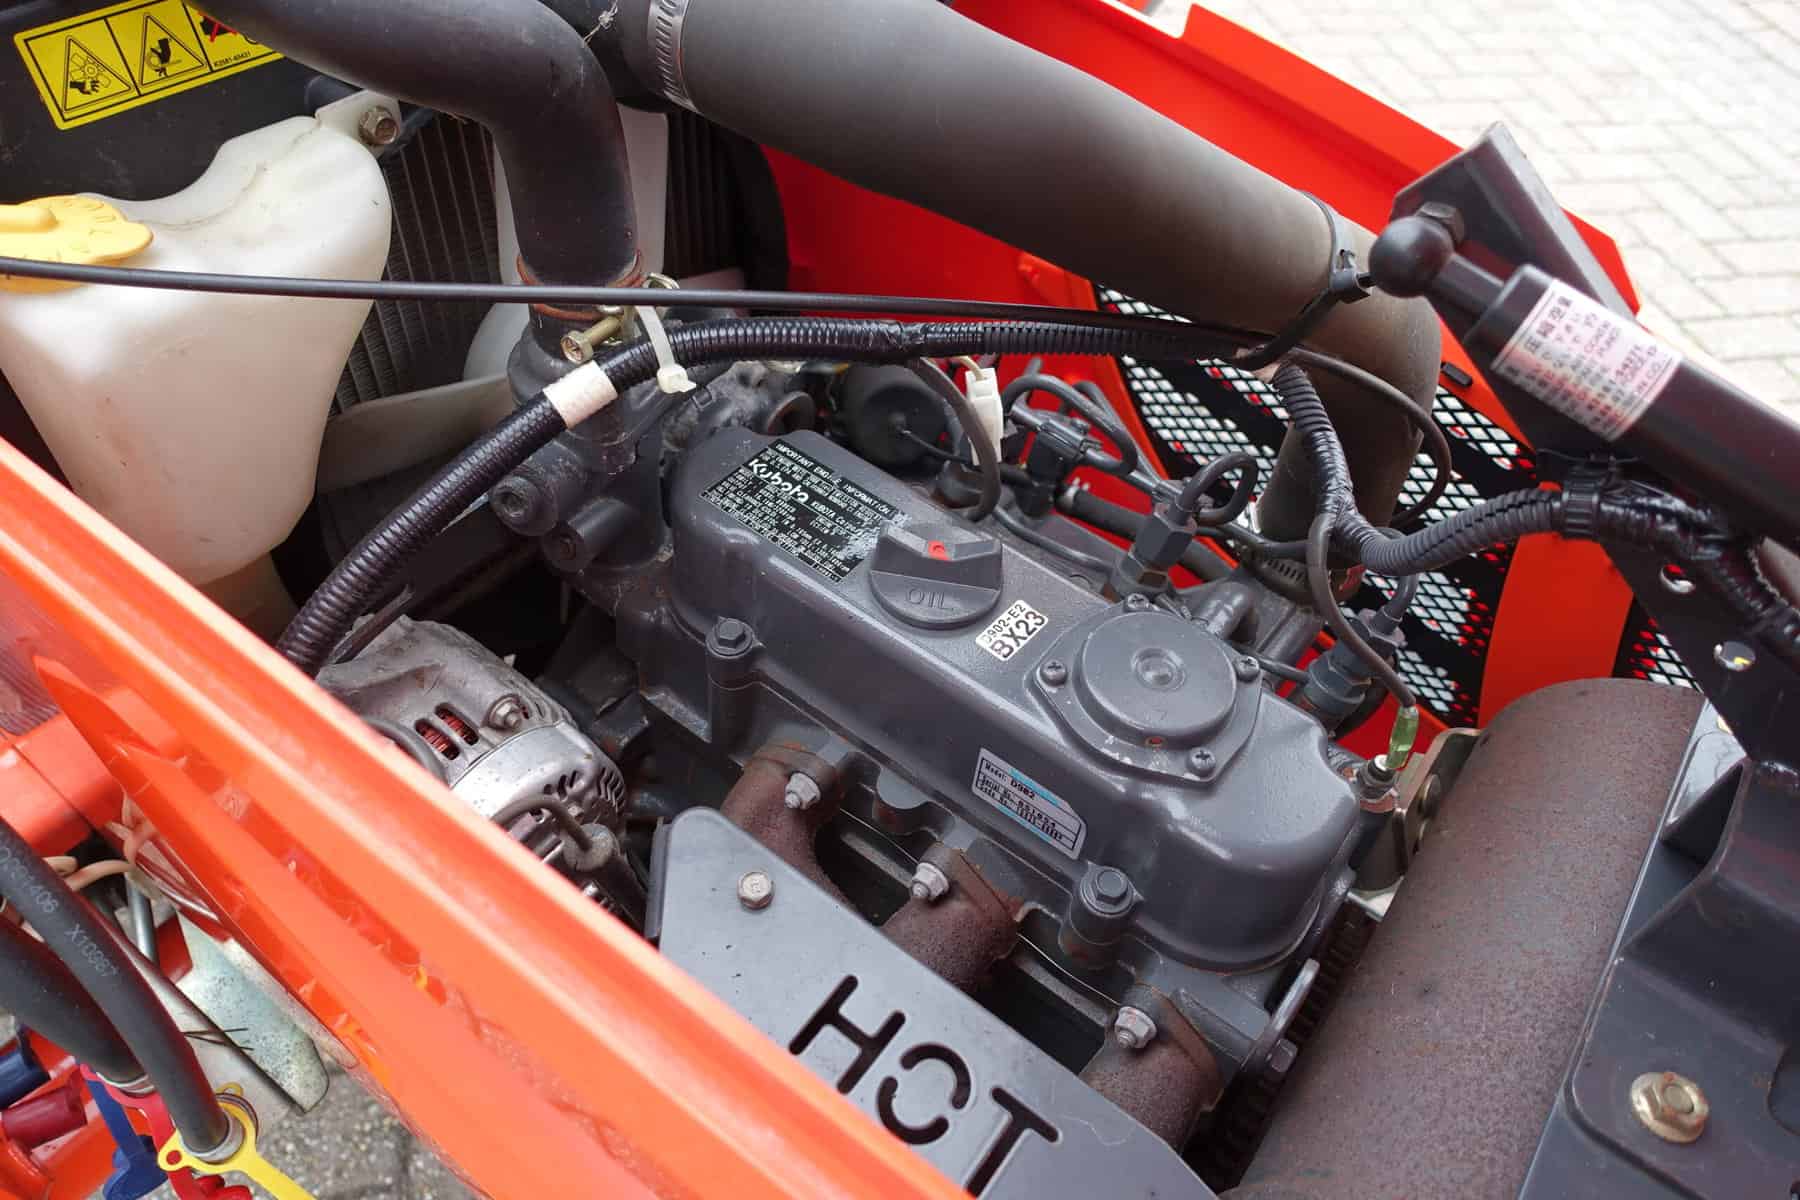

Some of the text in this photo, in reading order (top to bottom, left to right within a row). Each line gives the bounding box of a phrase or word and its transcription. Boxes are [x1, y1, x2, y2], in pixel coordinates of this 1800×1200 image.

[748, 459, 810, 502] Kubota
[776, 444, 891, 514] IMPORTANT ENGIE INFORMATION
[907, 587, 954, 611] OIL
[980, 604, 1026, 643] D902-E2
[991, 611, 1045, 658] BX23
[788, 974, 1060, 1197] HOT
